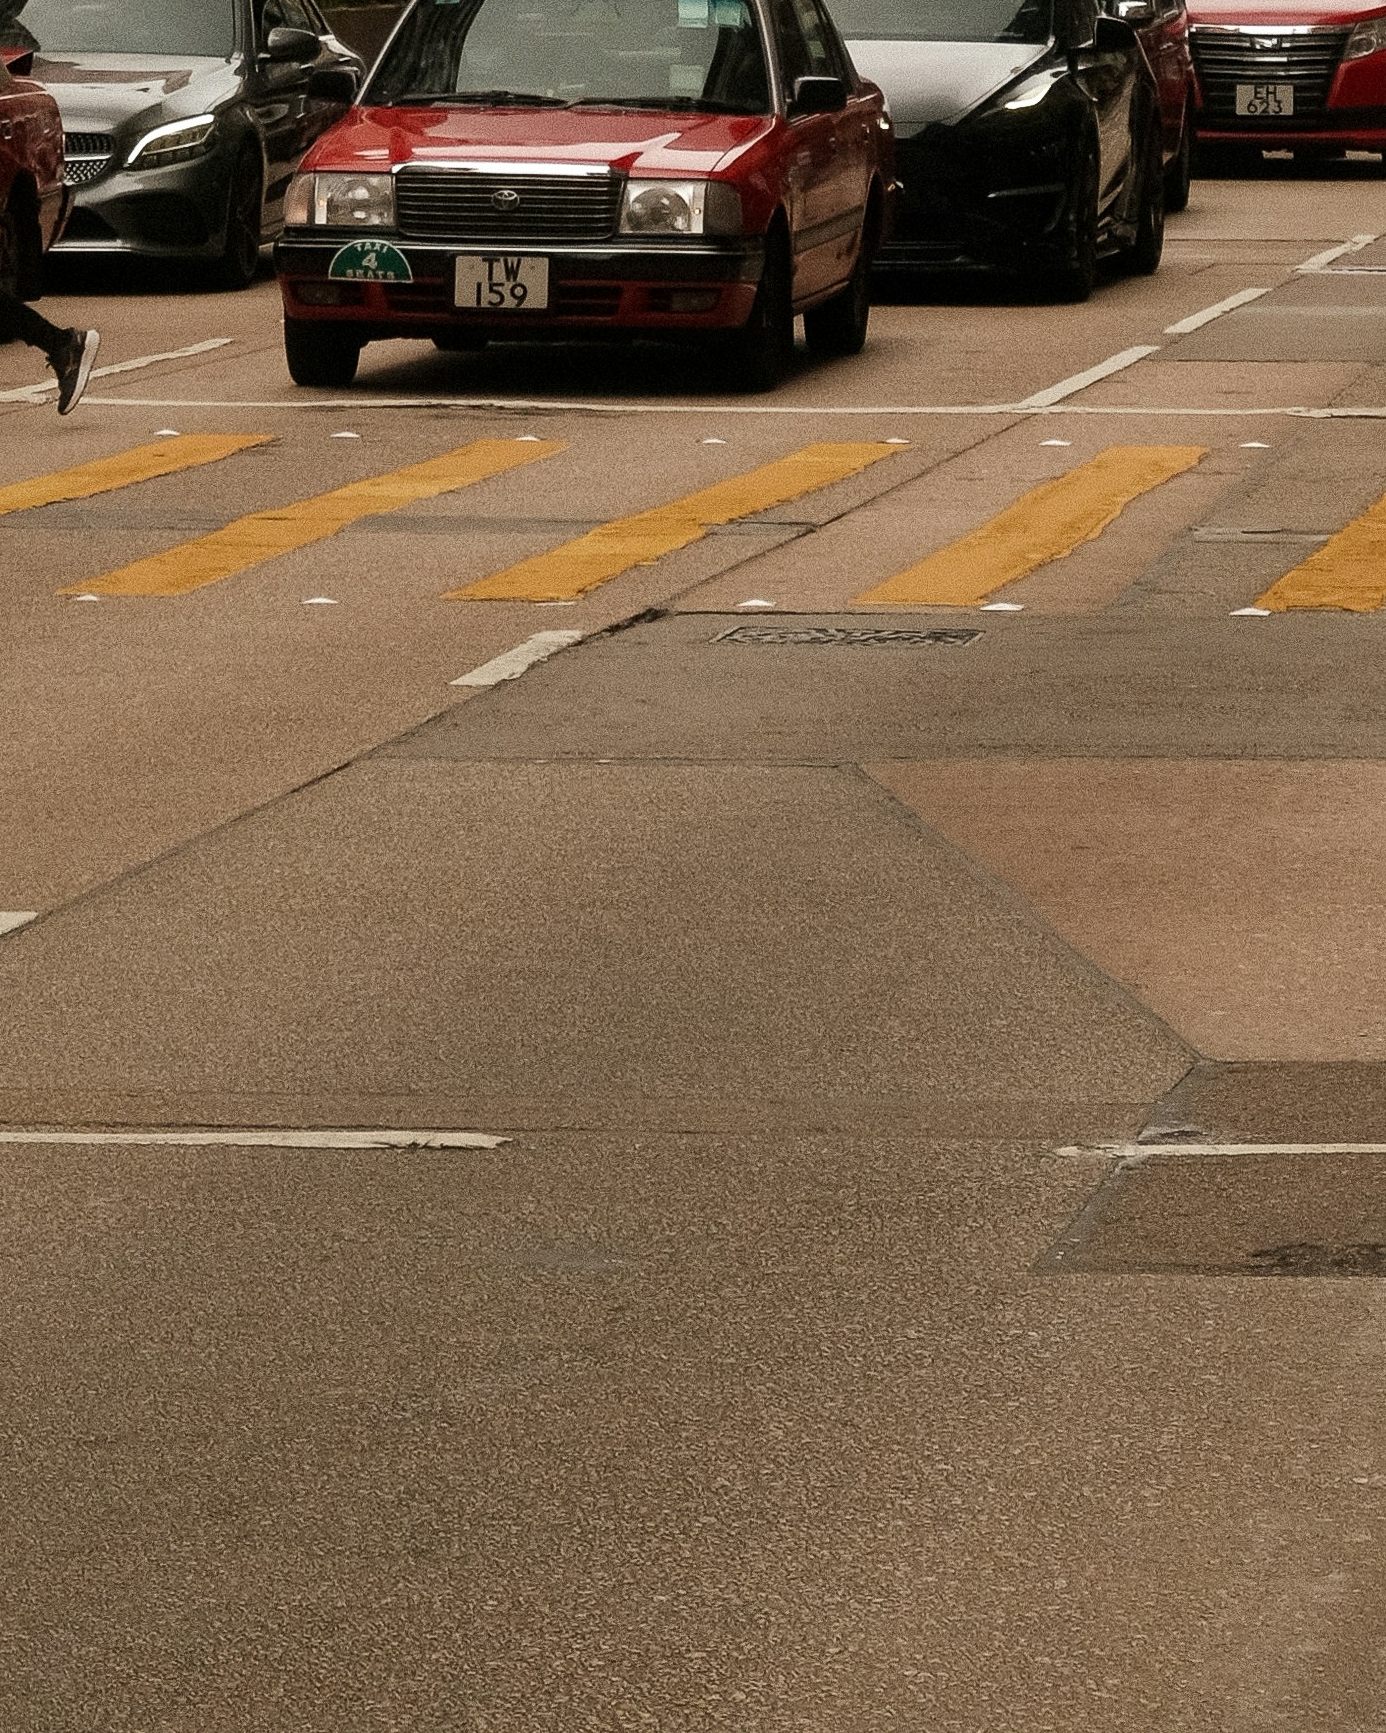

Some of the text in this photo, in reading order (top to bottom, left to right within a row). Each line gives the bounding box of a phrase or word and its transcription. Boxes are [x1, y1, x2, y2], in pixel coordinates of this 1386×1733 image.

[1254, 84, 1278, 101] EH
[1246, 100, 1283, 115] 623
[354, 242, 390, 254] TAXI
[361, 252, 378, 269] 4
[344, 268, 396, 280] SEATS
[482, 257, 522, 282] TW
[475, 282, 528, 307] 159
